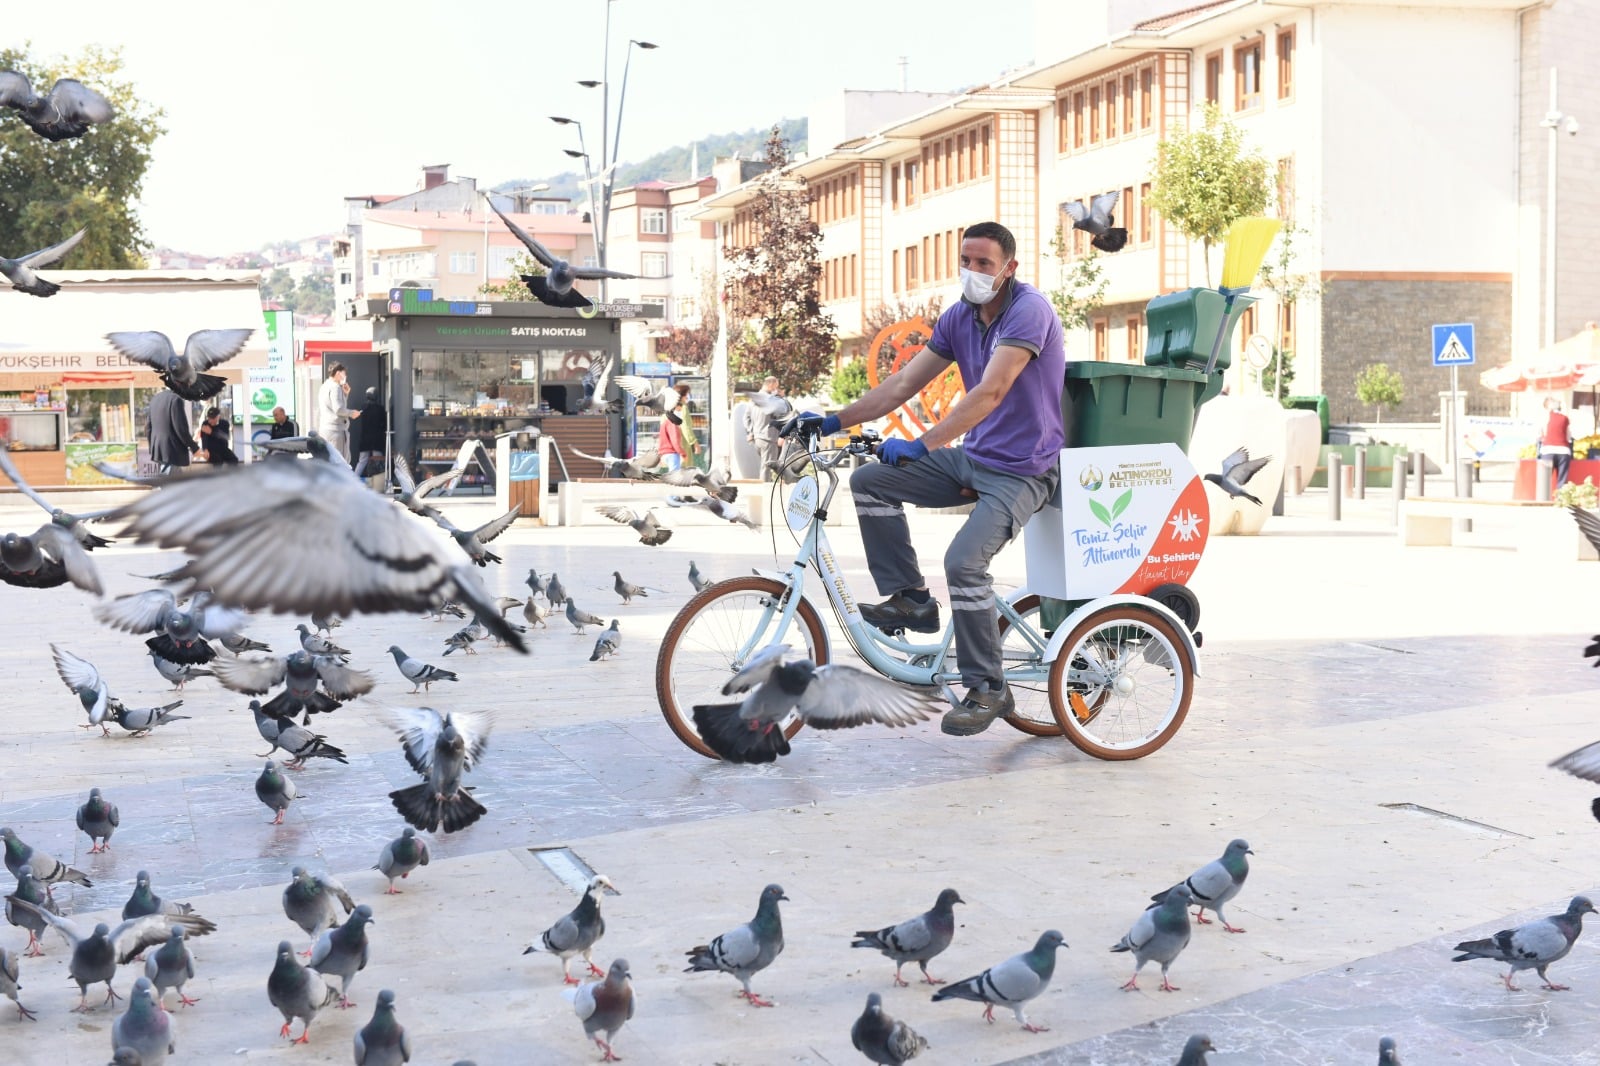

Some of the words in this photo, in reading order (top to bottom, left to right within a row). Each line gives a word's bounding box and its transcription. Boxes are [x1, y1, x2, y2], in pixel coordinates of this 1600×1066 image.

[511, 327, 540, 337] SATIŞ
[542, 328, 586, 337] NOKTASI
[1109, 468, 1172, 480] ALTINORDU
[1071, 528, 1109, 546] Temiz
[1112, 523, 1147, 543] Şehir
[1147, 555, 1160, 563] Bu
[1163, 552, 1200, 564] Şehirde
